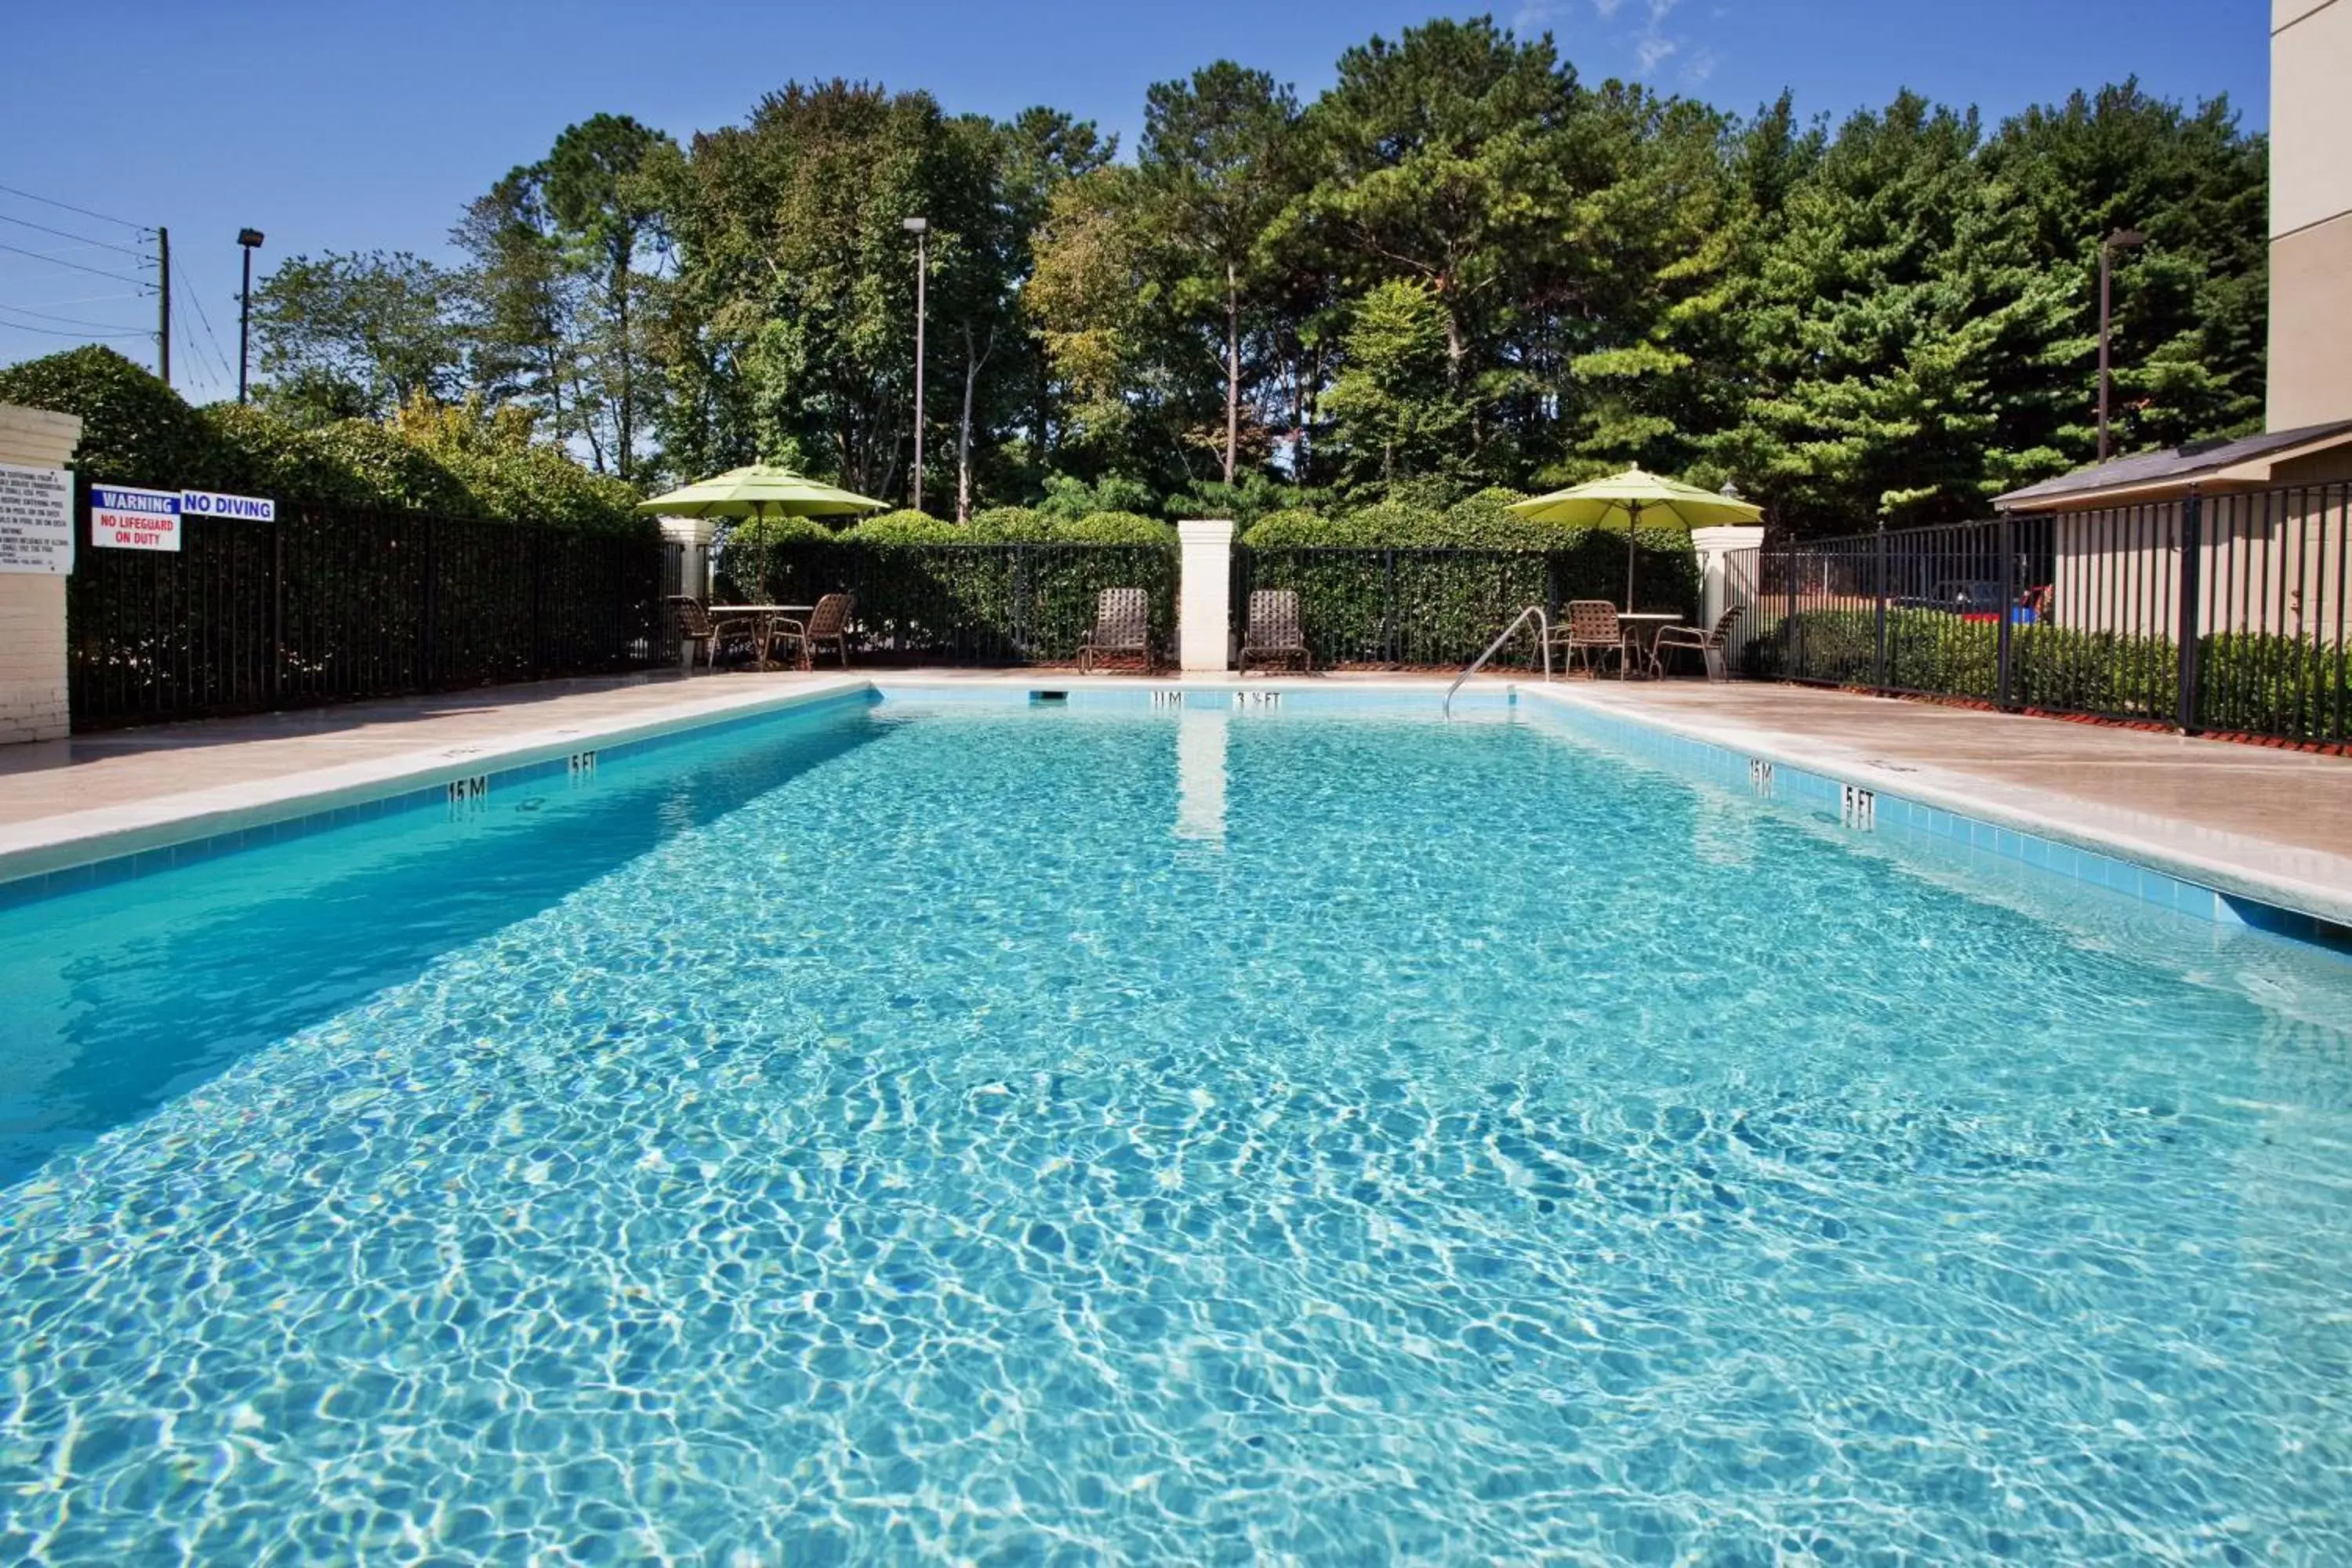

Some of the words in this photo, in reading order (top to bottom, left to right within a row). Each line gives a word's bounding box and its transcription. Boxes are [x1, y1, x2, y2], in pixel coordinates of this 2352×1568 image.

[103, 492, 172, 513] WARNING
[184, 494, 210, 512] NO
[216, 498, 270, 518] DIVING
[100, 514, 116, 528] NO
[120, 515, 173, 532] LIFEGUARD
[115, 531, 131, 543] ON
[134, 532, 160, 546] DUTY
[1846, 786, 1853, 809] 5
[1858, 789, 1874, 815] FT
